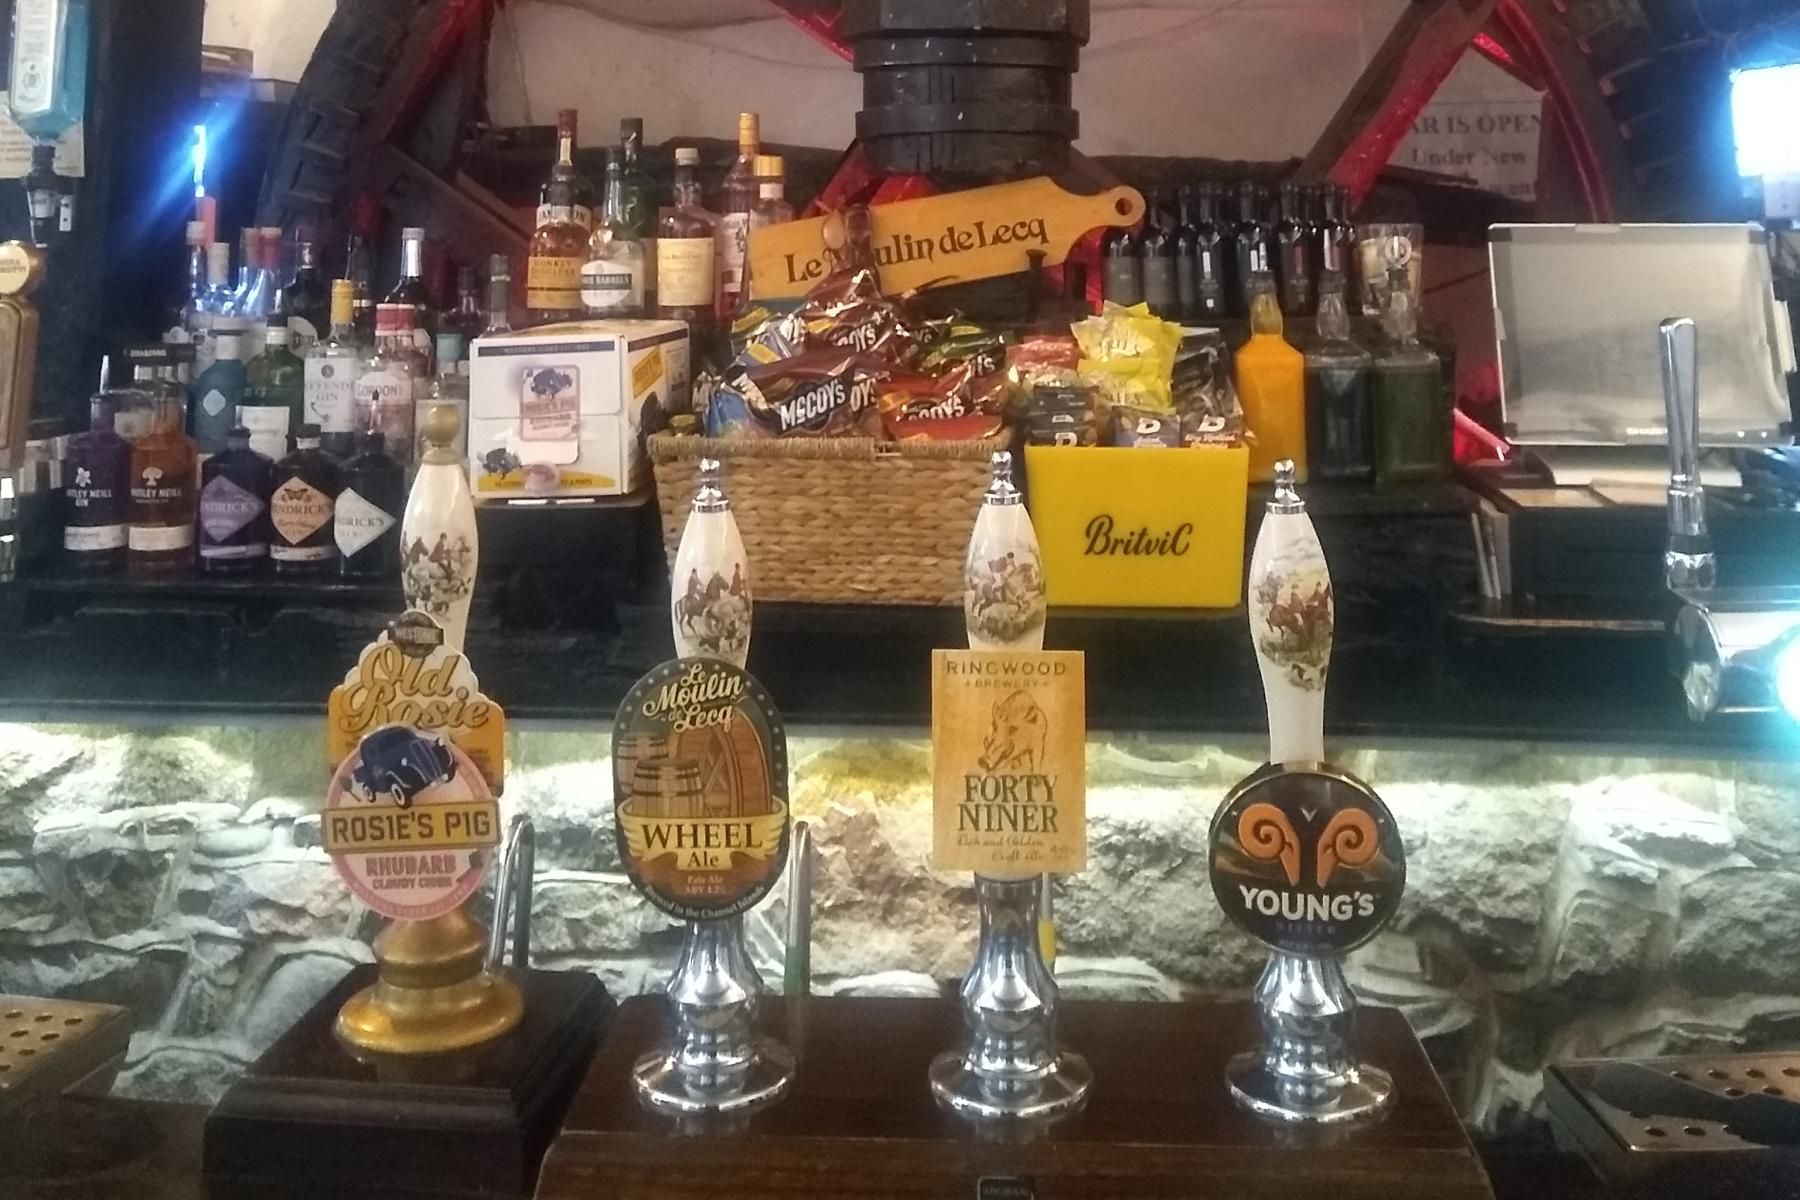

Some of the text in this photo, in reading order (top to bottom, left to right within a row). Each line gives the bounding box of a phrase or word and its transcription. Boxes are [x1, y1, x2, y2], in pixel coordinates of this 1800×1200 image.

[1447, 116, 1470, 134] IS
[1412, 149, 1474, 165] Under
[784, 218, 1050, 283] Le Mulin de Lecq
[361, 643, 461, 697] Old
[680, 663, 706, 686] Le
[946, 660, 1067, 676] RINGWOOD
[642, 671, 744, 716] Moulin
[975, 678, 1039, 688] BREWERY
[339, 679, 489, 734] Rosie
[673, 704, 735, 733] Lecq
[964, 773, 1058, 803] FORTY
[332, 810, 491, 844] ROSIE'S PIG
[958, 803, 1060, 833] NINER
[641, 823, 763, 849] WHEEL
[365, 854, 457, 877] RHUBARB
[687, 850, 720, 868] Ale
[372, 876, 453, 890] CLOUDY CIDER
[1239, 885, 1375, 922] YOUNG'S
